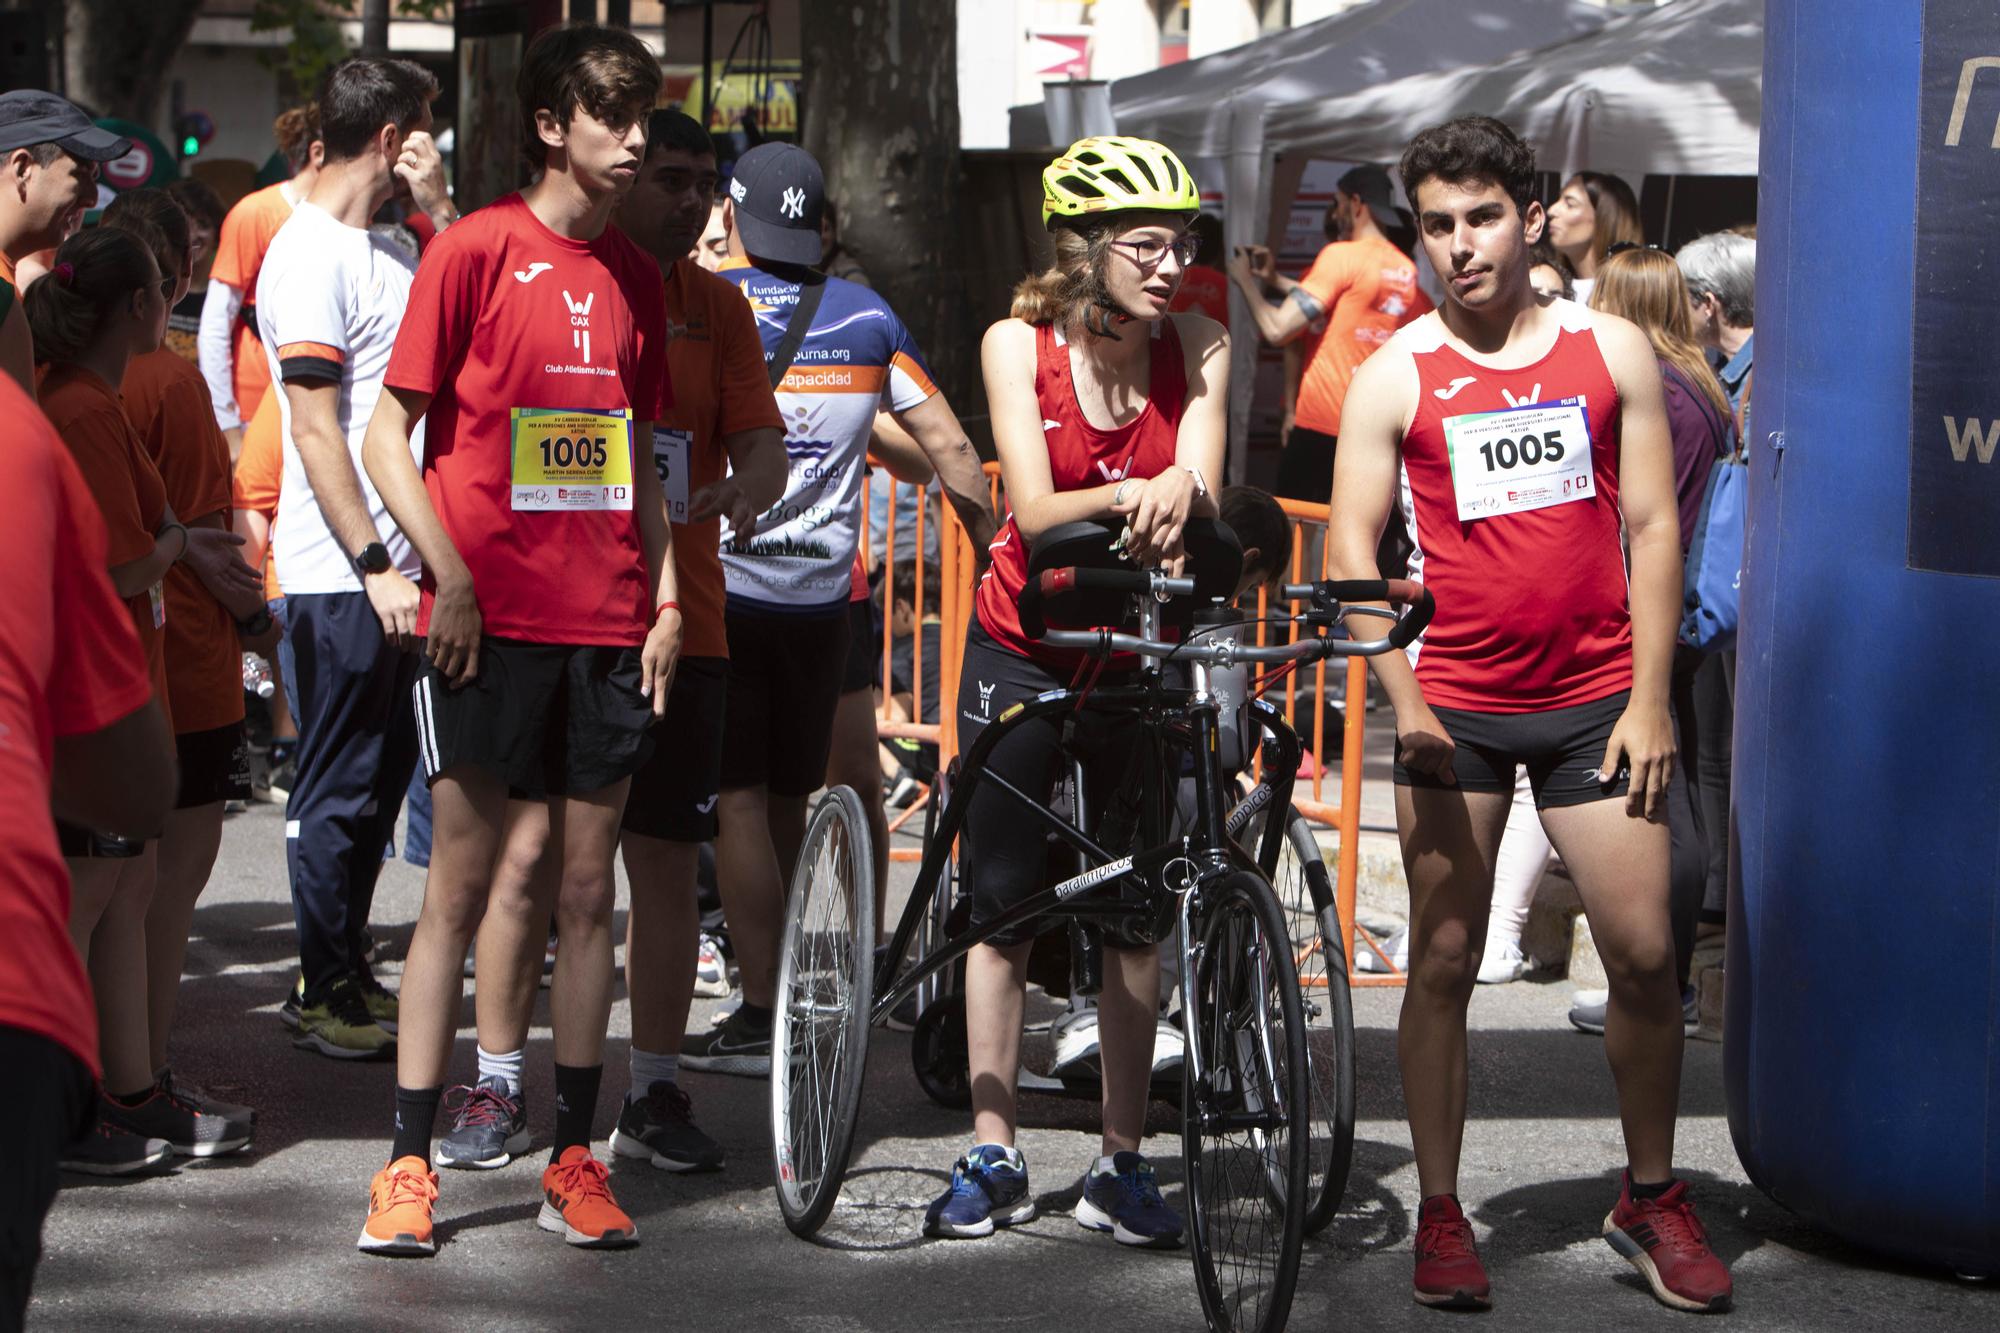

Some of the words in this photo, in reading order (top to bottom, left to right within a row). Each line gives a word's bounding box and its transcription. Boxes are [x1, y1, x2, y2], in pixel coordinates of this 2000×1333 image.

[571, 315, 589, 327] CAX
[545, 364, 563, 373] Club
[564, 365, 595, 375] Atletisme
[540, 436, 608, 467] 1005
[1479, 430, 1565, 472] 1005
[654, 453, 670, 481] 5
[1226, 784, 1272, 833] limpicos
